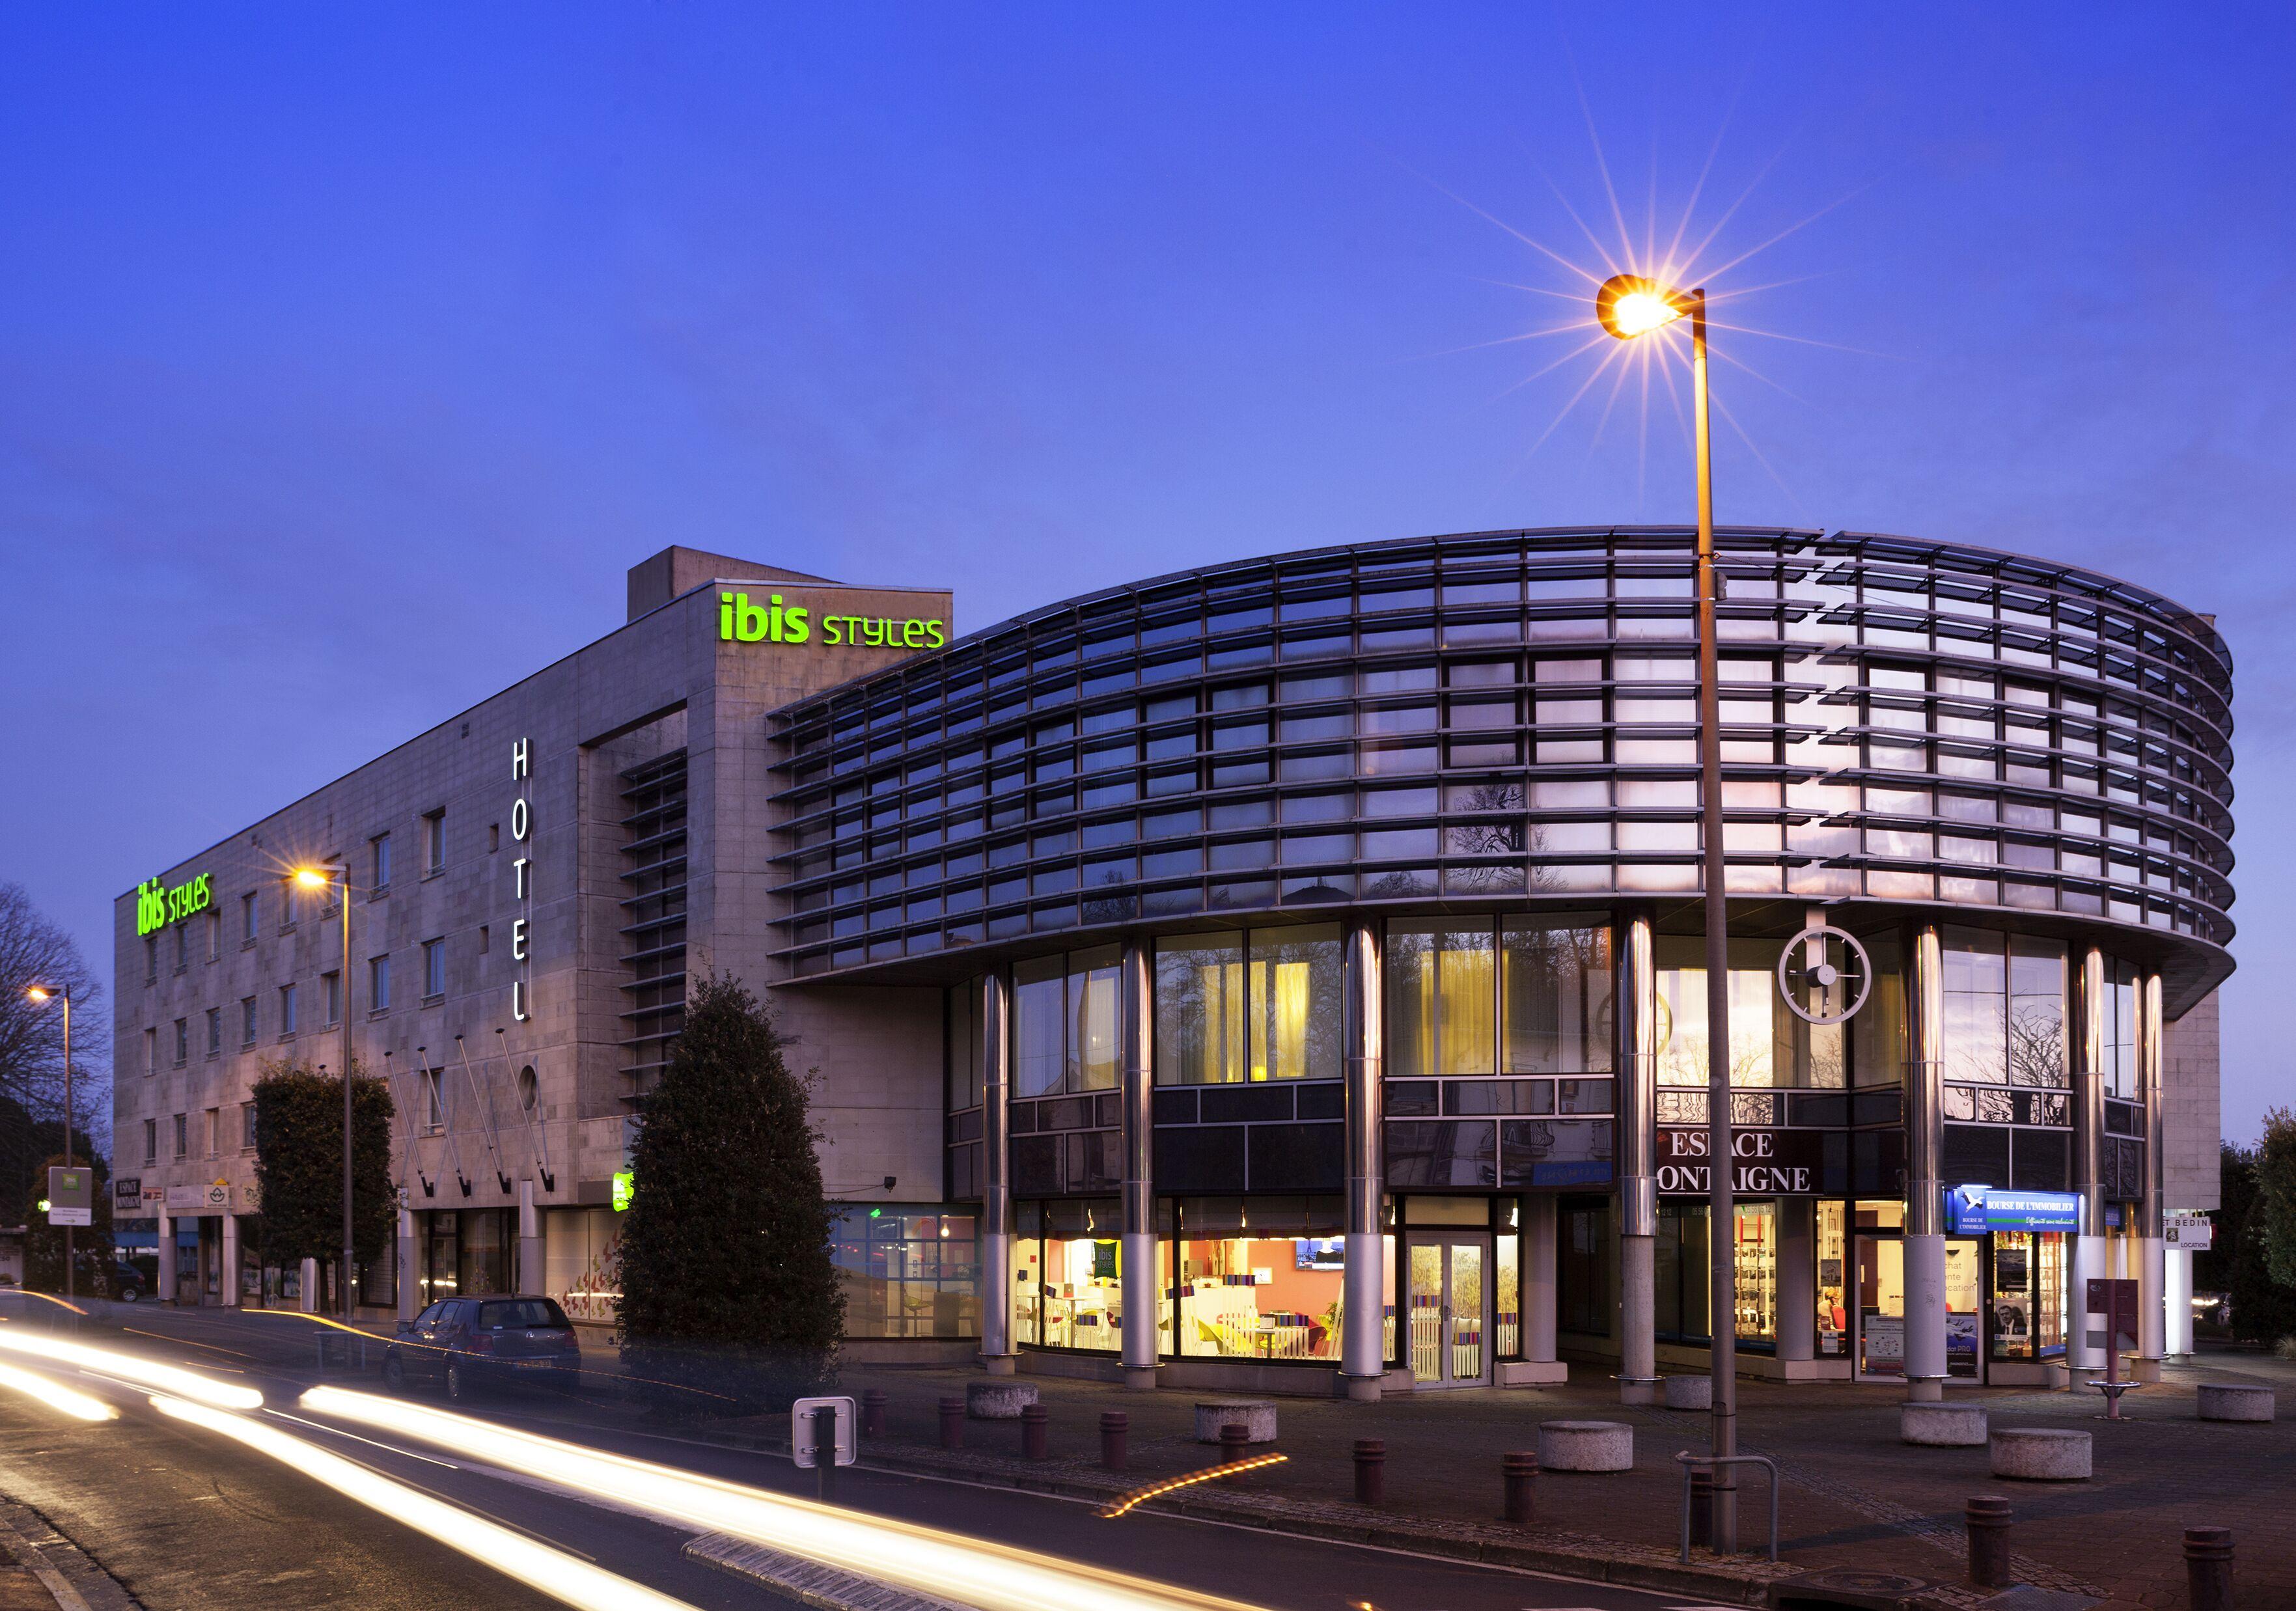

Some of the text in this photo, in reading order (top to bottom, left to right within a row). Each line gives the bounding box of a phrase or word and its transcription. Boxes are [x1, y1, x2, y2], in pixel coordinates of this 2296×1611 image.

[721, 592, 810, 643] ibis
[512, 737, 528, 1021] HOTEL
[138, 877, 165, 936] ibis
[1670, 1132, 1773, 1157] ESCE
[1657, 1166, 1810, 1191] ONTIGNE
[1987, 1201, 2074, 1211] BOURSE DE L'IMMOBILIER
[1099, 1248, 1112, 1260] ibis
